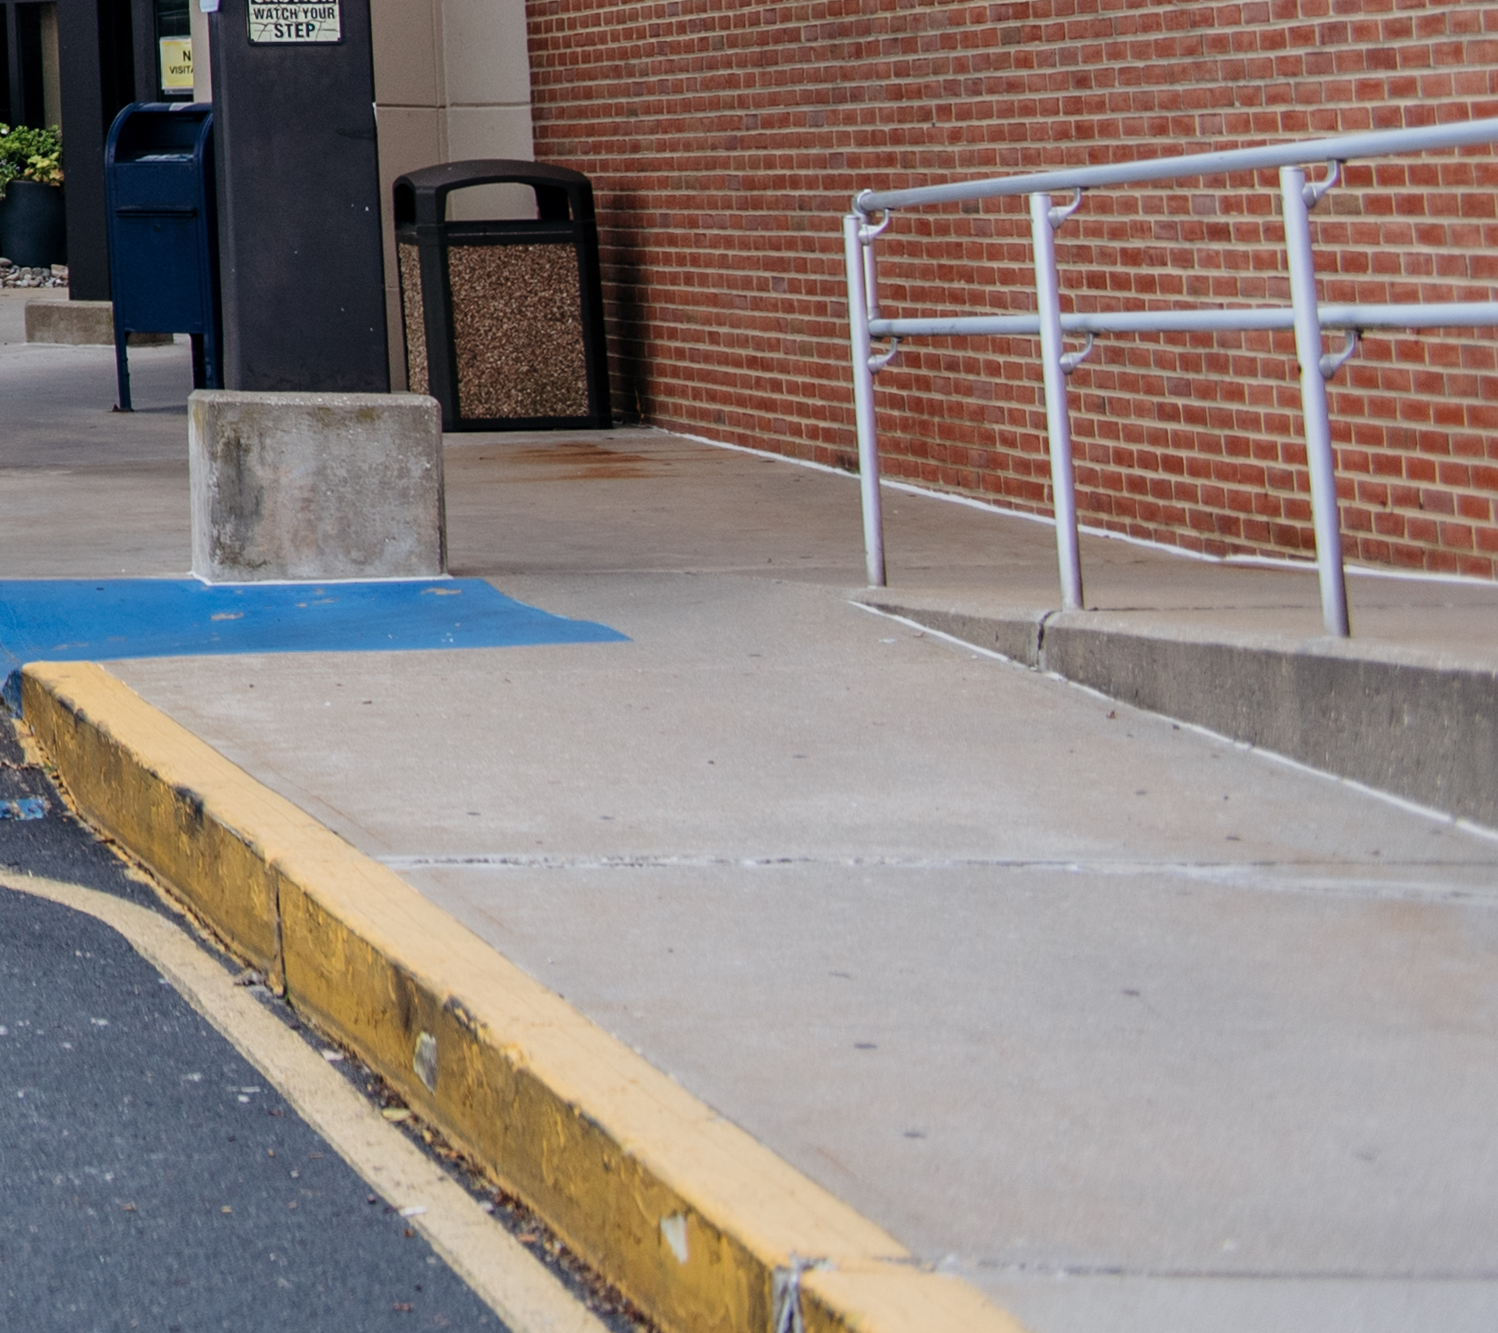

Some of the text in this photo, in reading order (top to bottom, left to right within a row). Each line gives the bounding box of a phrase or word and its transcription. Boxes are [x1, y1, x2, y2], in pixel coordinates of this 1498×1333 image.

[253, 7, 335, 20] WATCH YOUR
[274, 23, 316, 39] STEP
